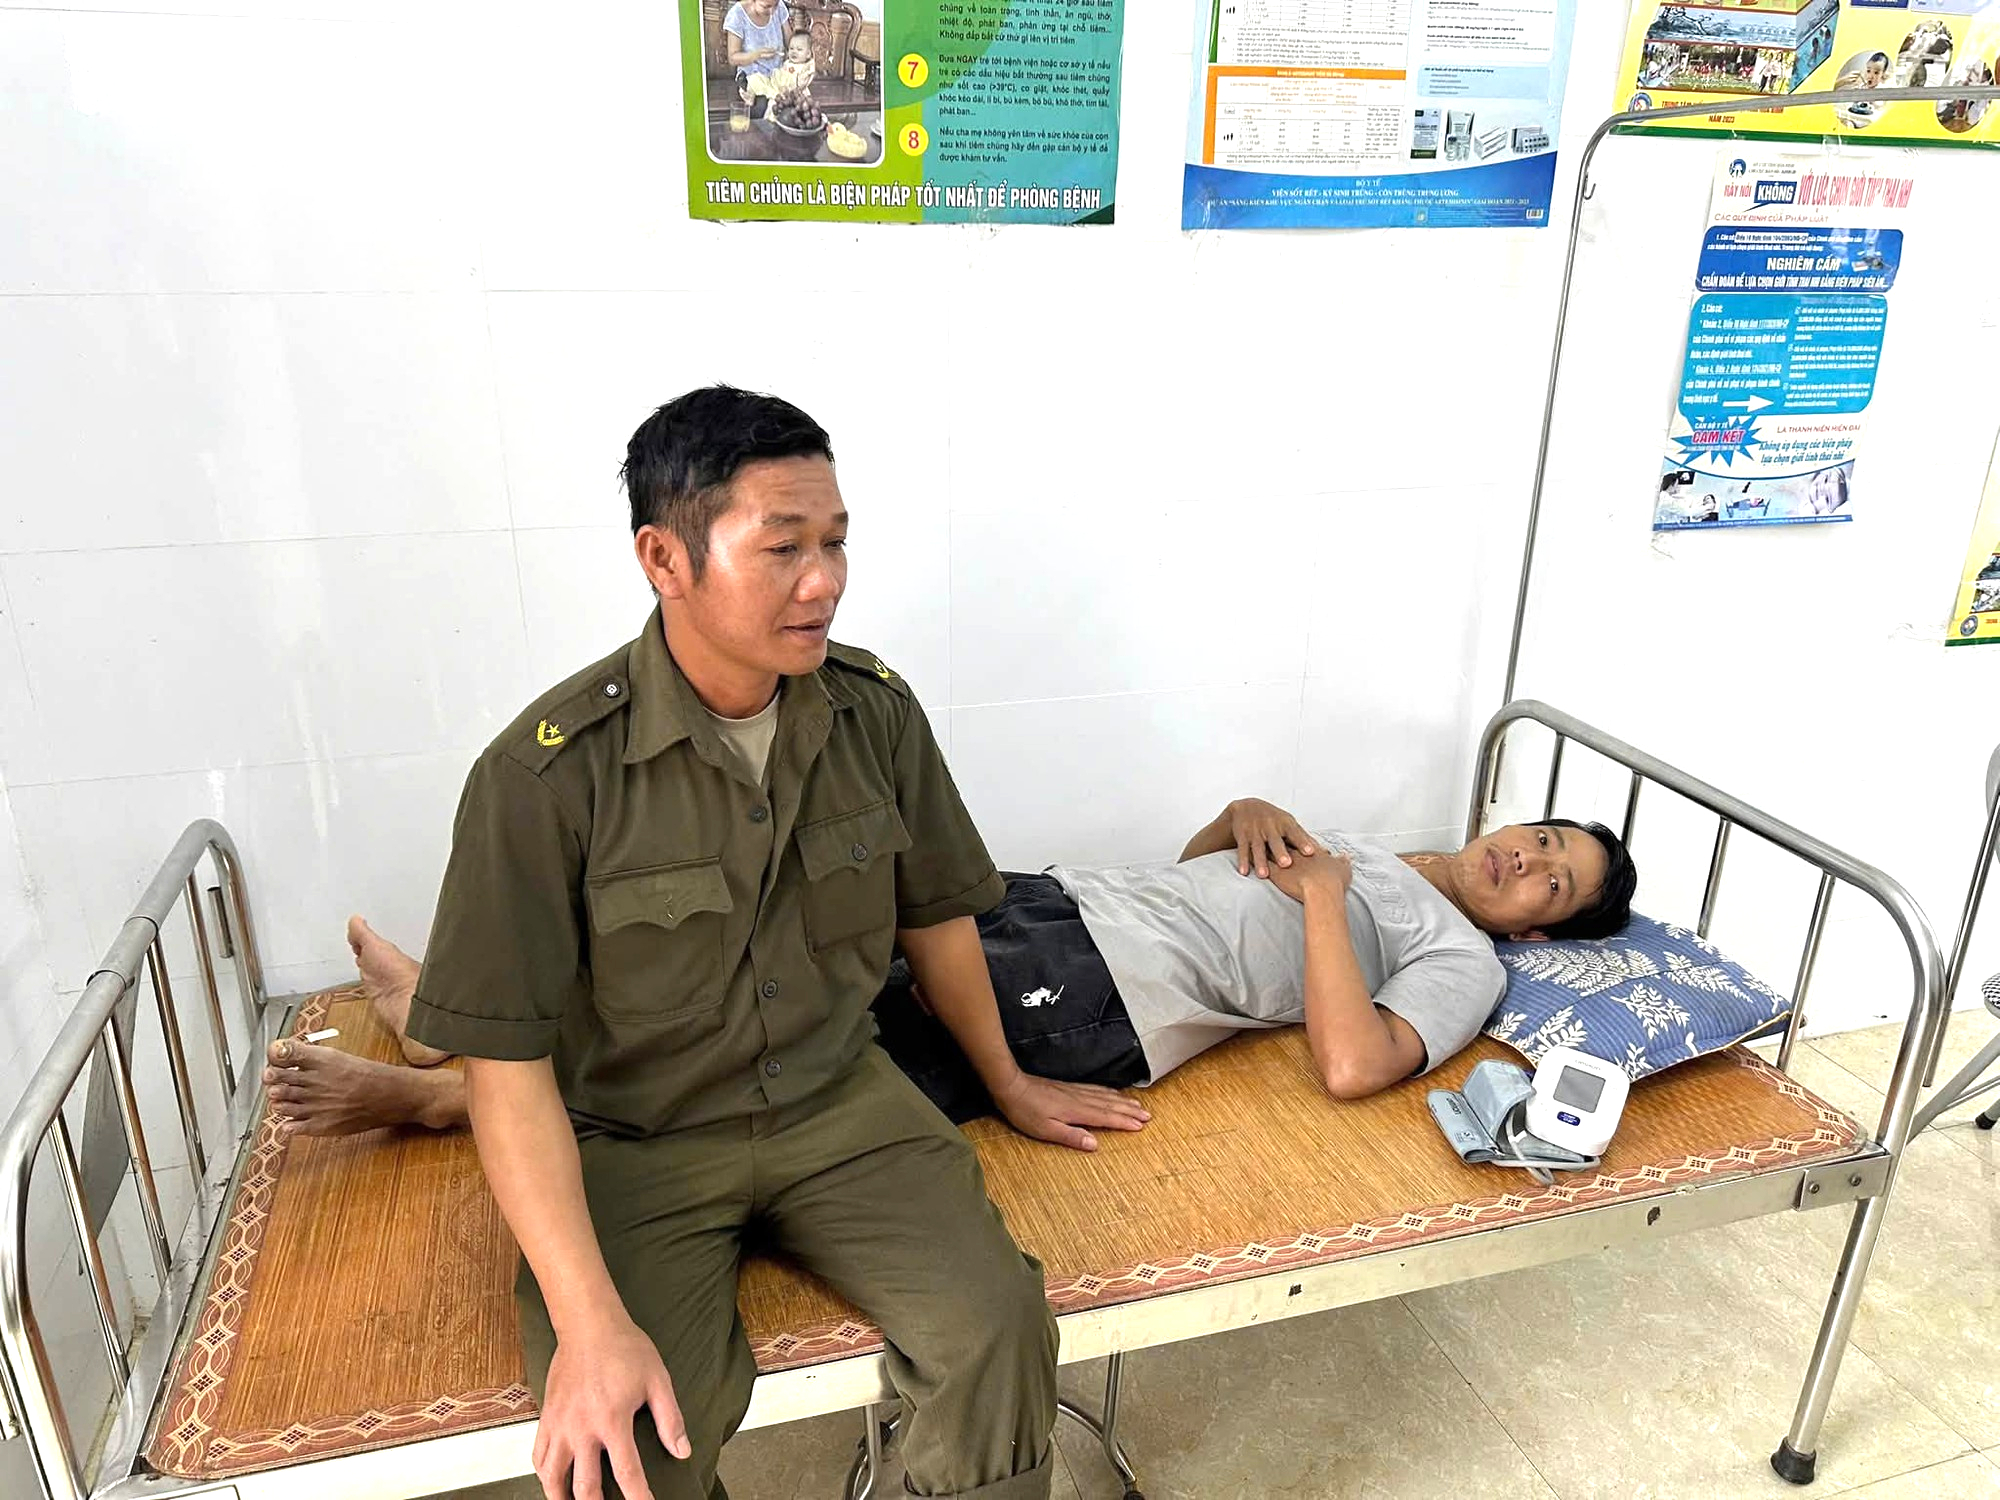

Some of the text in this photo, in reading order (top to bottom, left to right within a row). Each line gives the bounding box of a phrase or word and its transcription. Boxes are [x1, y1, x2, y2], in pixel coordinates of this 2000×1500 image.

[940, 30, 964, 40] Không
[957, 55, 978, 64] NGAY
[908, 62, 918, 80] 7
[909, 131, 919, 149] 8
[956, 127, 969, 136] cha
[706, 176, 1101, 213] TIÊM CHỦNG LÀ BIỆN PHÁP TỐT NHẤT ĐỂ PHÒNG BỆNH
[1757, 182, 1794, 201] KHÔNG
[1797, 168, 1815, 206] VỚI
[1812, 172, 1829, 213] LỰA
[1766, 254, 1841, 271] NGHIÊM CẤM
[1692, 430, 1720, 444] CAM
[1759, 440, 1781, 452] Không
